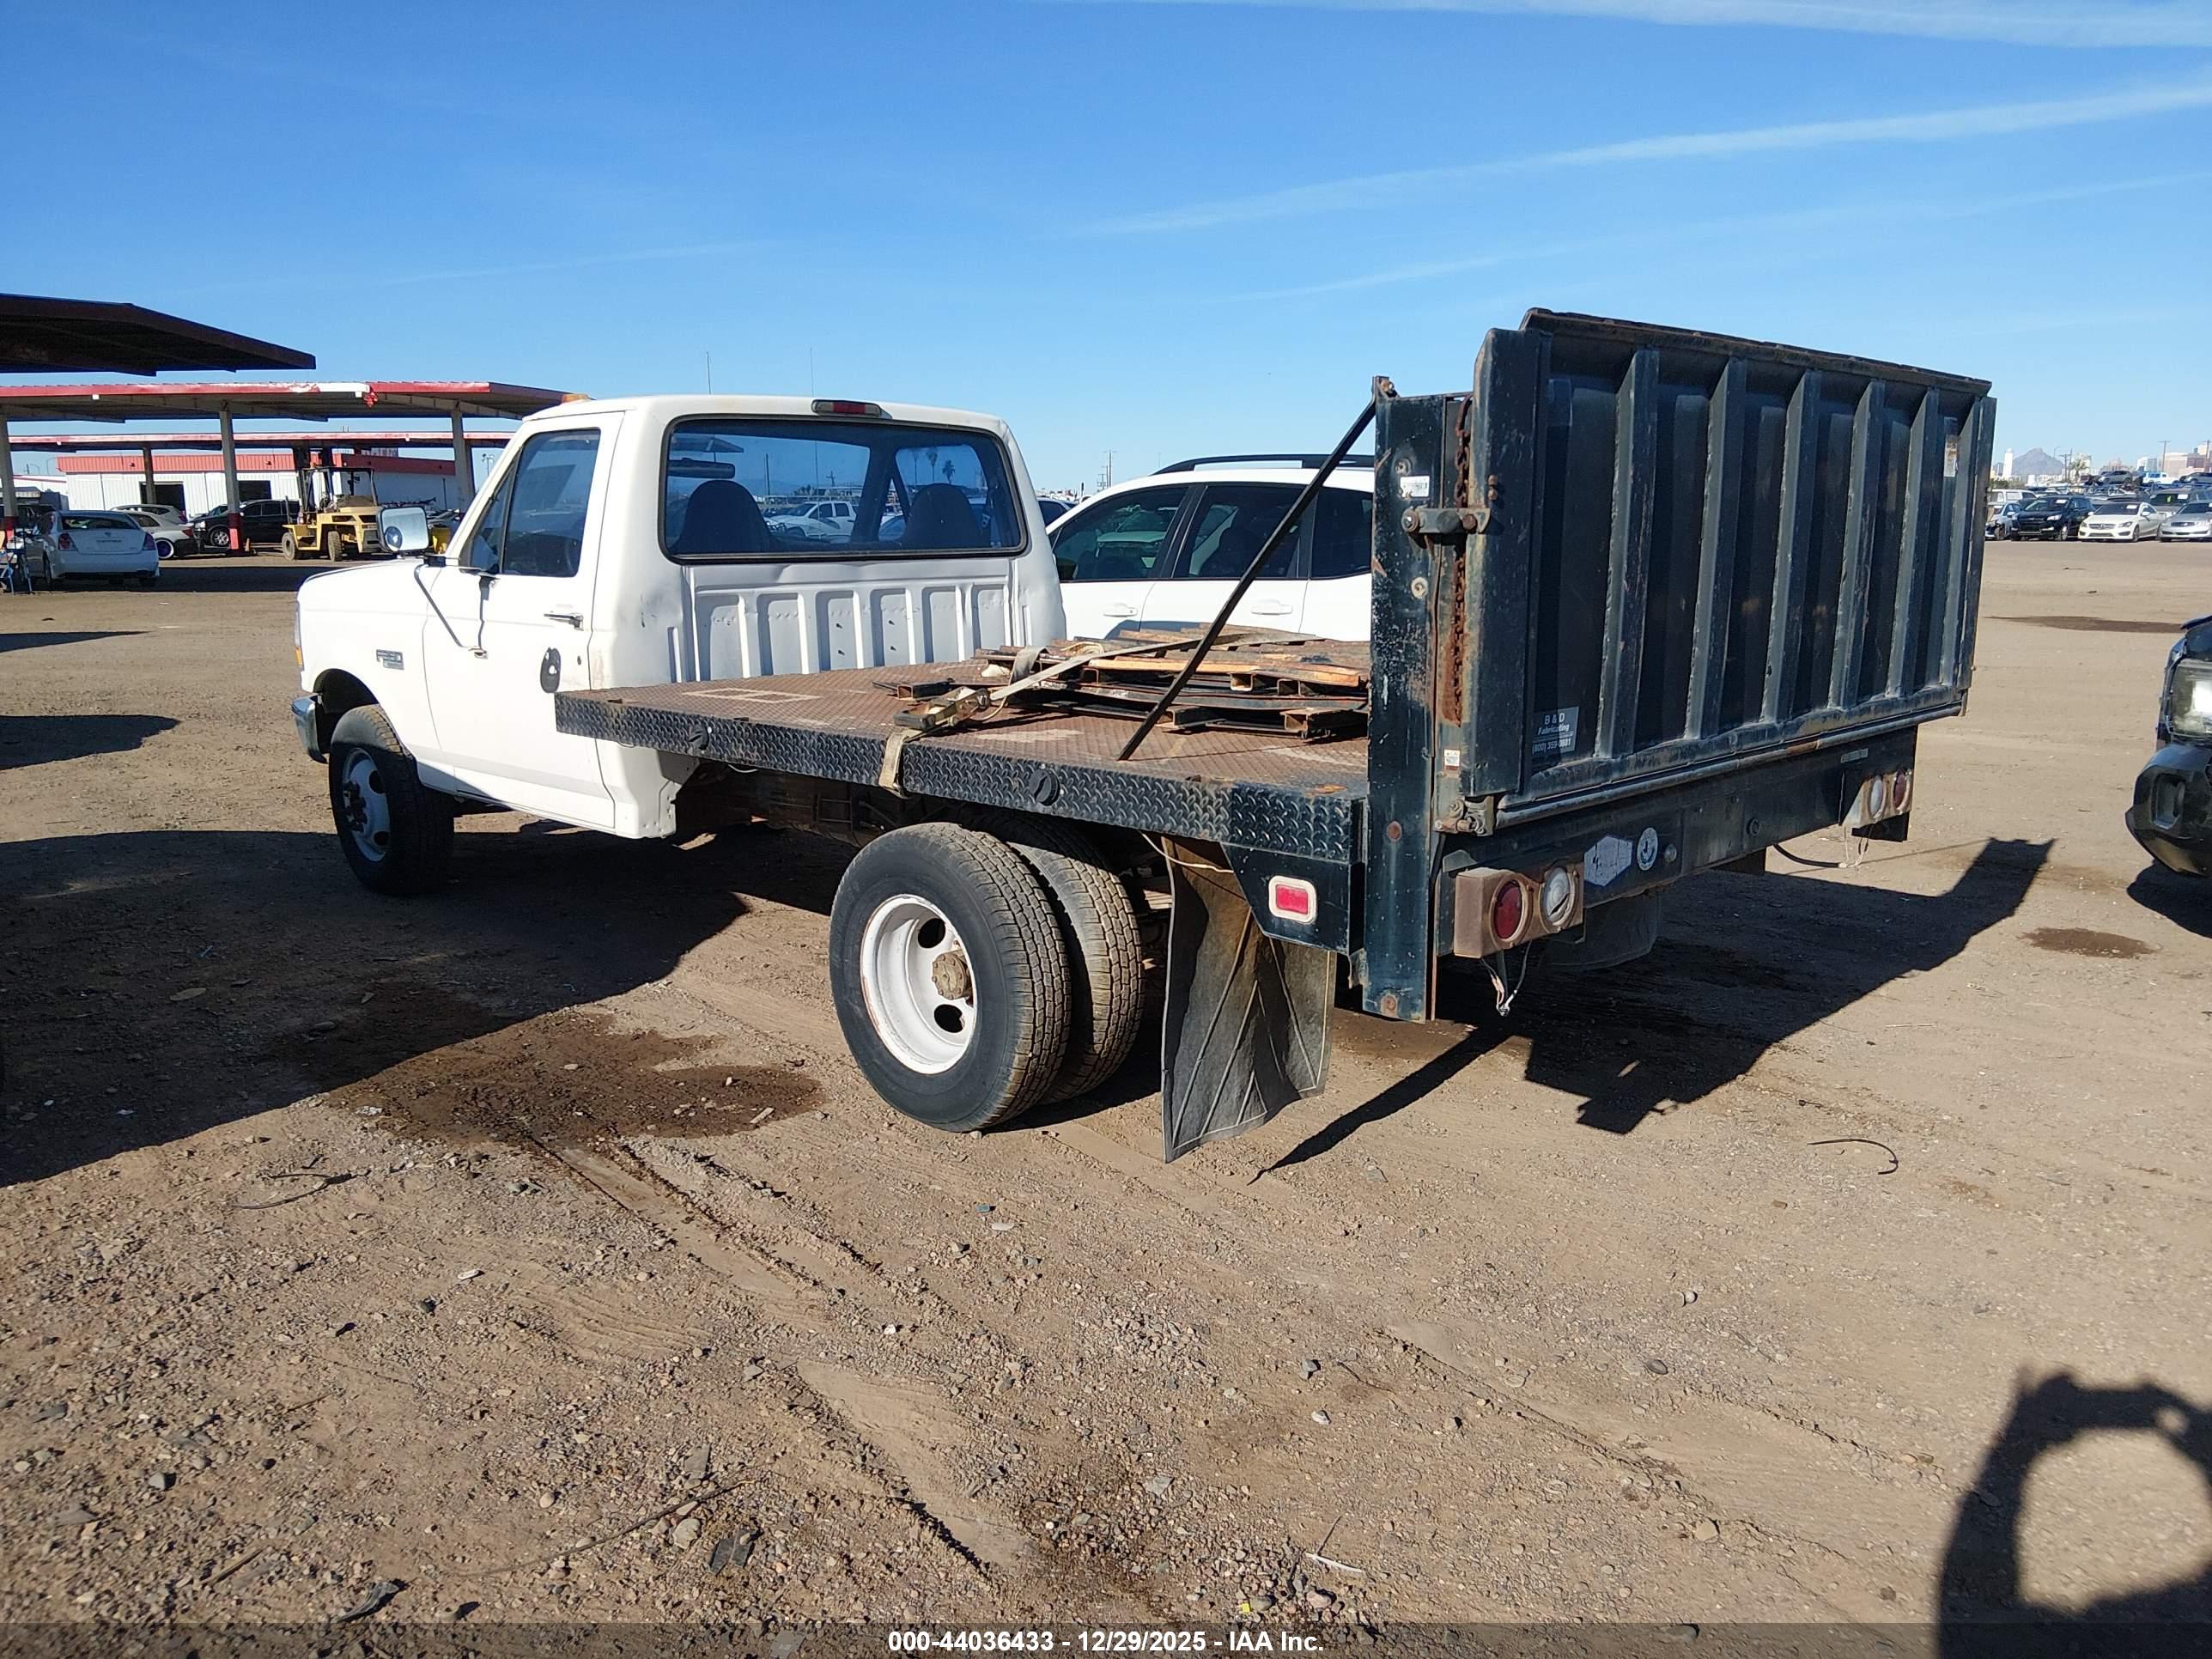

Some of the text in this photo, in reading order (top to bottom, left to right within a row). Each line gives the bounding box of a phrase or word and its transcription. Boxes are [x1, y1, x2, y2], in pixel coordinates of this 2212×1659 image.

[1544, 713, 1565, 726] B & D
[1537, 724, 1571, 736] Fabricating
